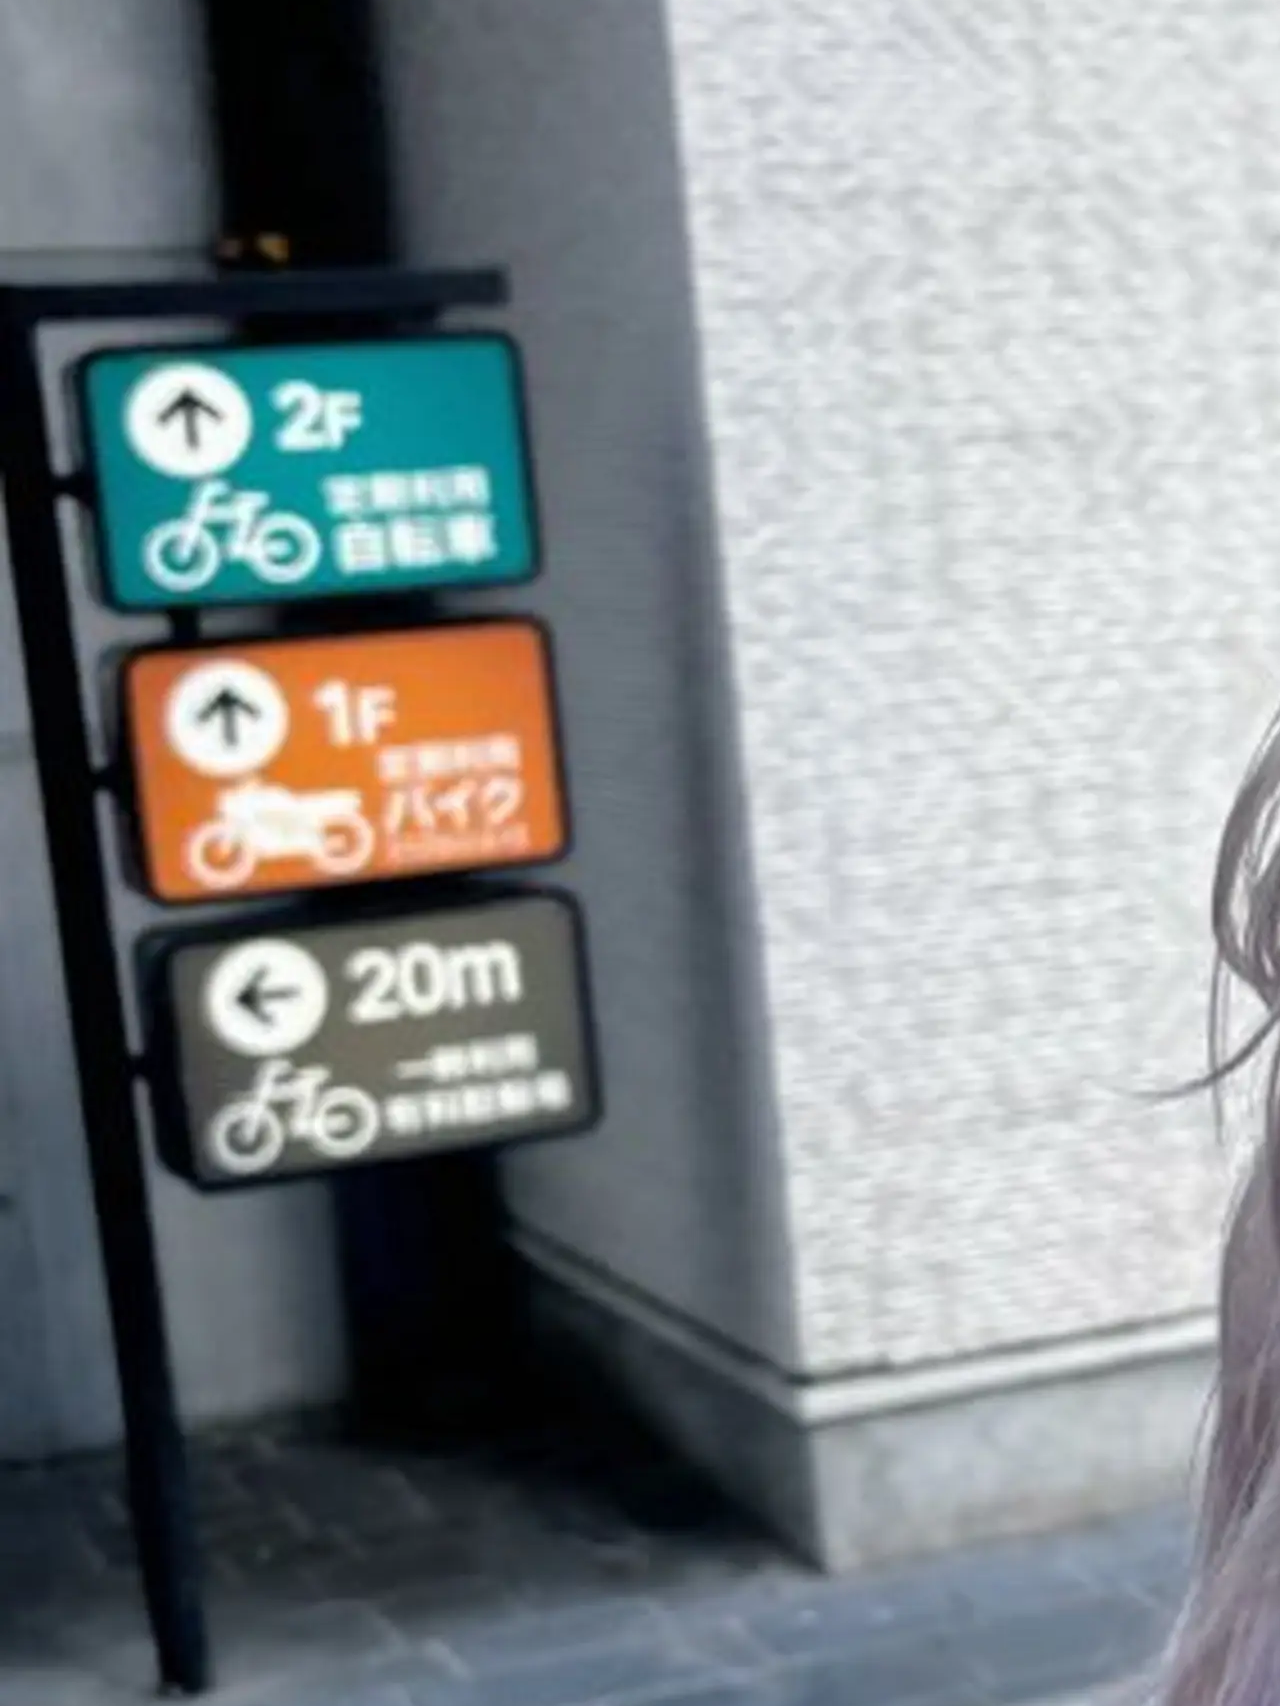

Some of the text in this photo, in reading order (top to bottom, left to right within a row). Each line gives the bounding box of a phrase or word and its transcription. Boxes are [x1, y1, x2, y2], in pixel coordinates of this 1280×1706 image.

[273, 379, 363, 451] 2F
[333, 515, 496, 574] 自転車
[313, 679, 397, 744] 1F
[385, 778, 523, 830] バイク
[347, 941, 521, 1023] 20m
